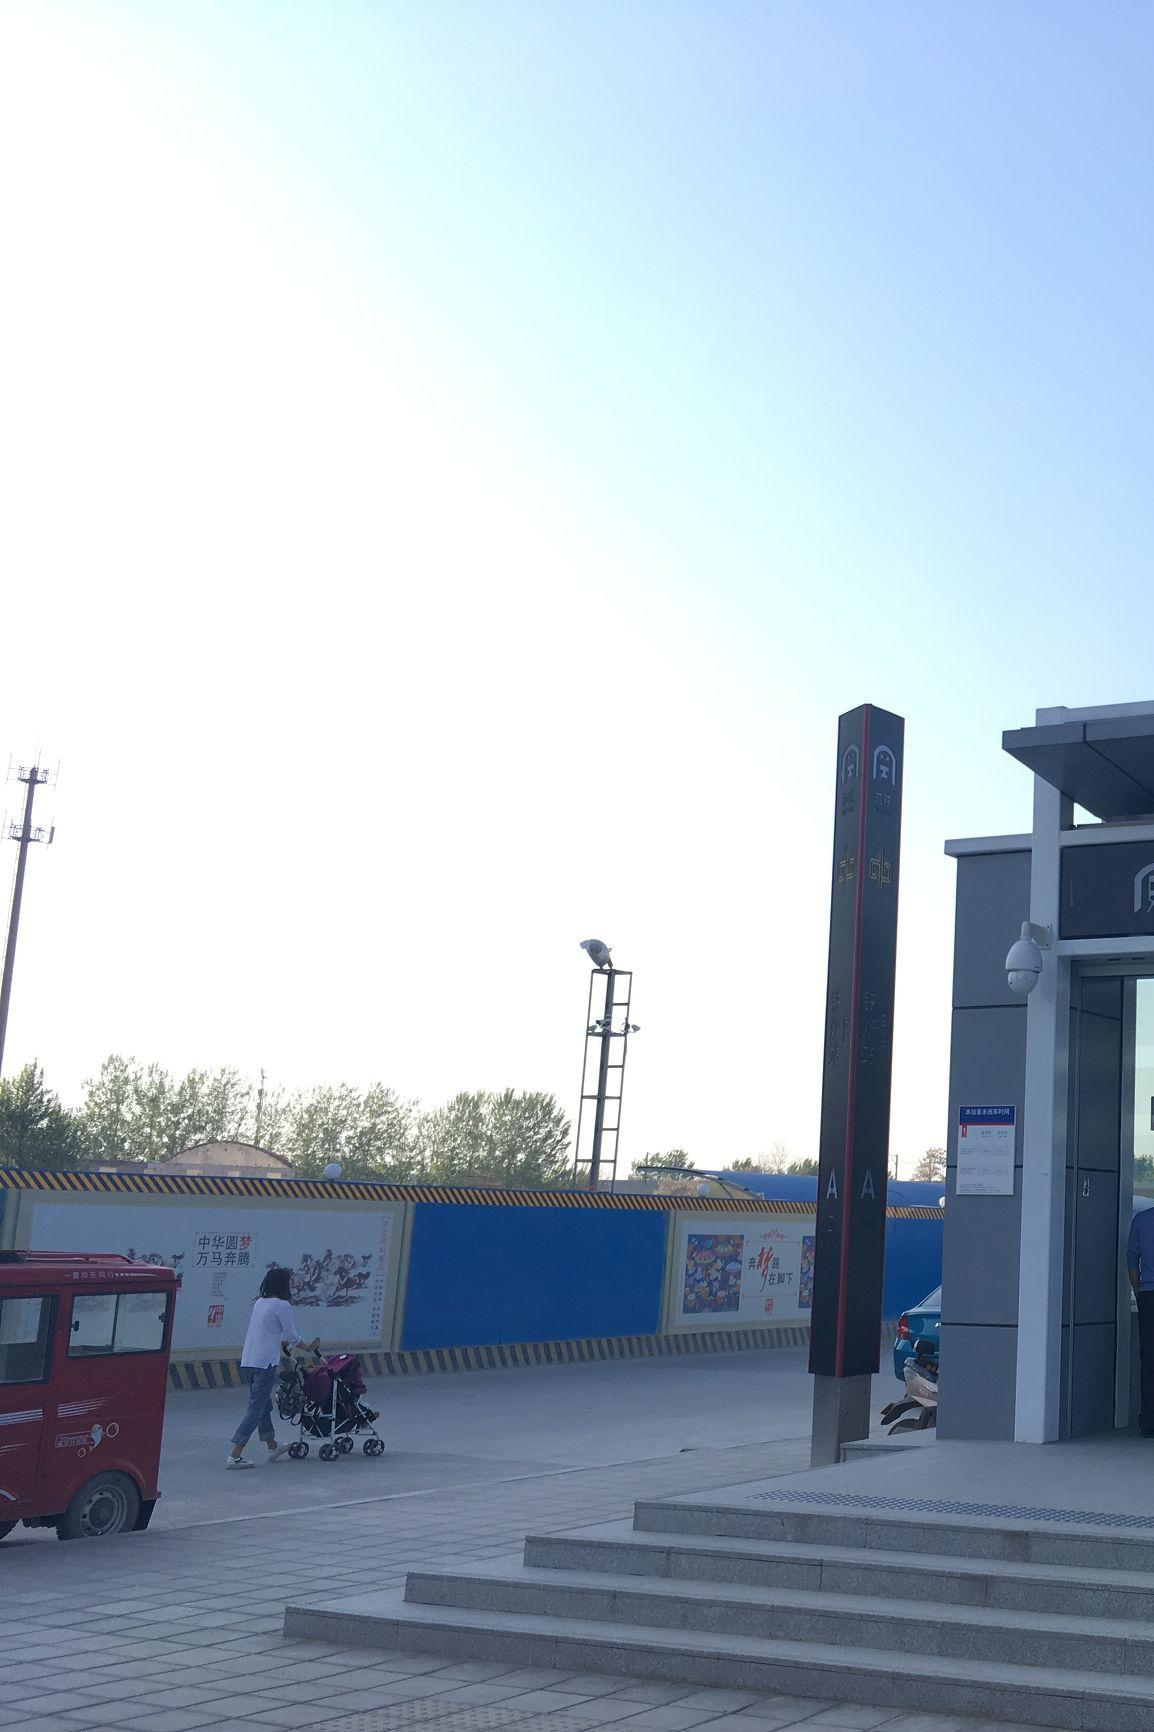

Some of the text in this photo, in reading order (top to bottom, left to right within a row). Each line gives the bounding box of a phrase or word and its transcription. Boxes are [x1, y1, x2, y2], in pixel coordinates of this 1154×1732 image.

[826, 1168, 838, 1200] A
[860, 1168, 875, 1200] A
[198, 1234, 252, 1251] 中华圆梦
[196, 1251, 250, 1267] 万马奔腾
[768, 1271, 794, 1286] 在脚下
